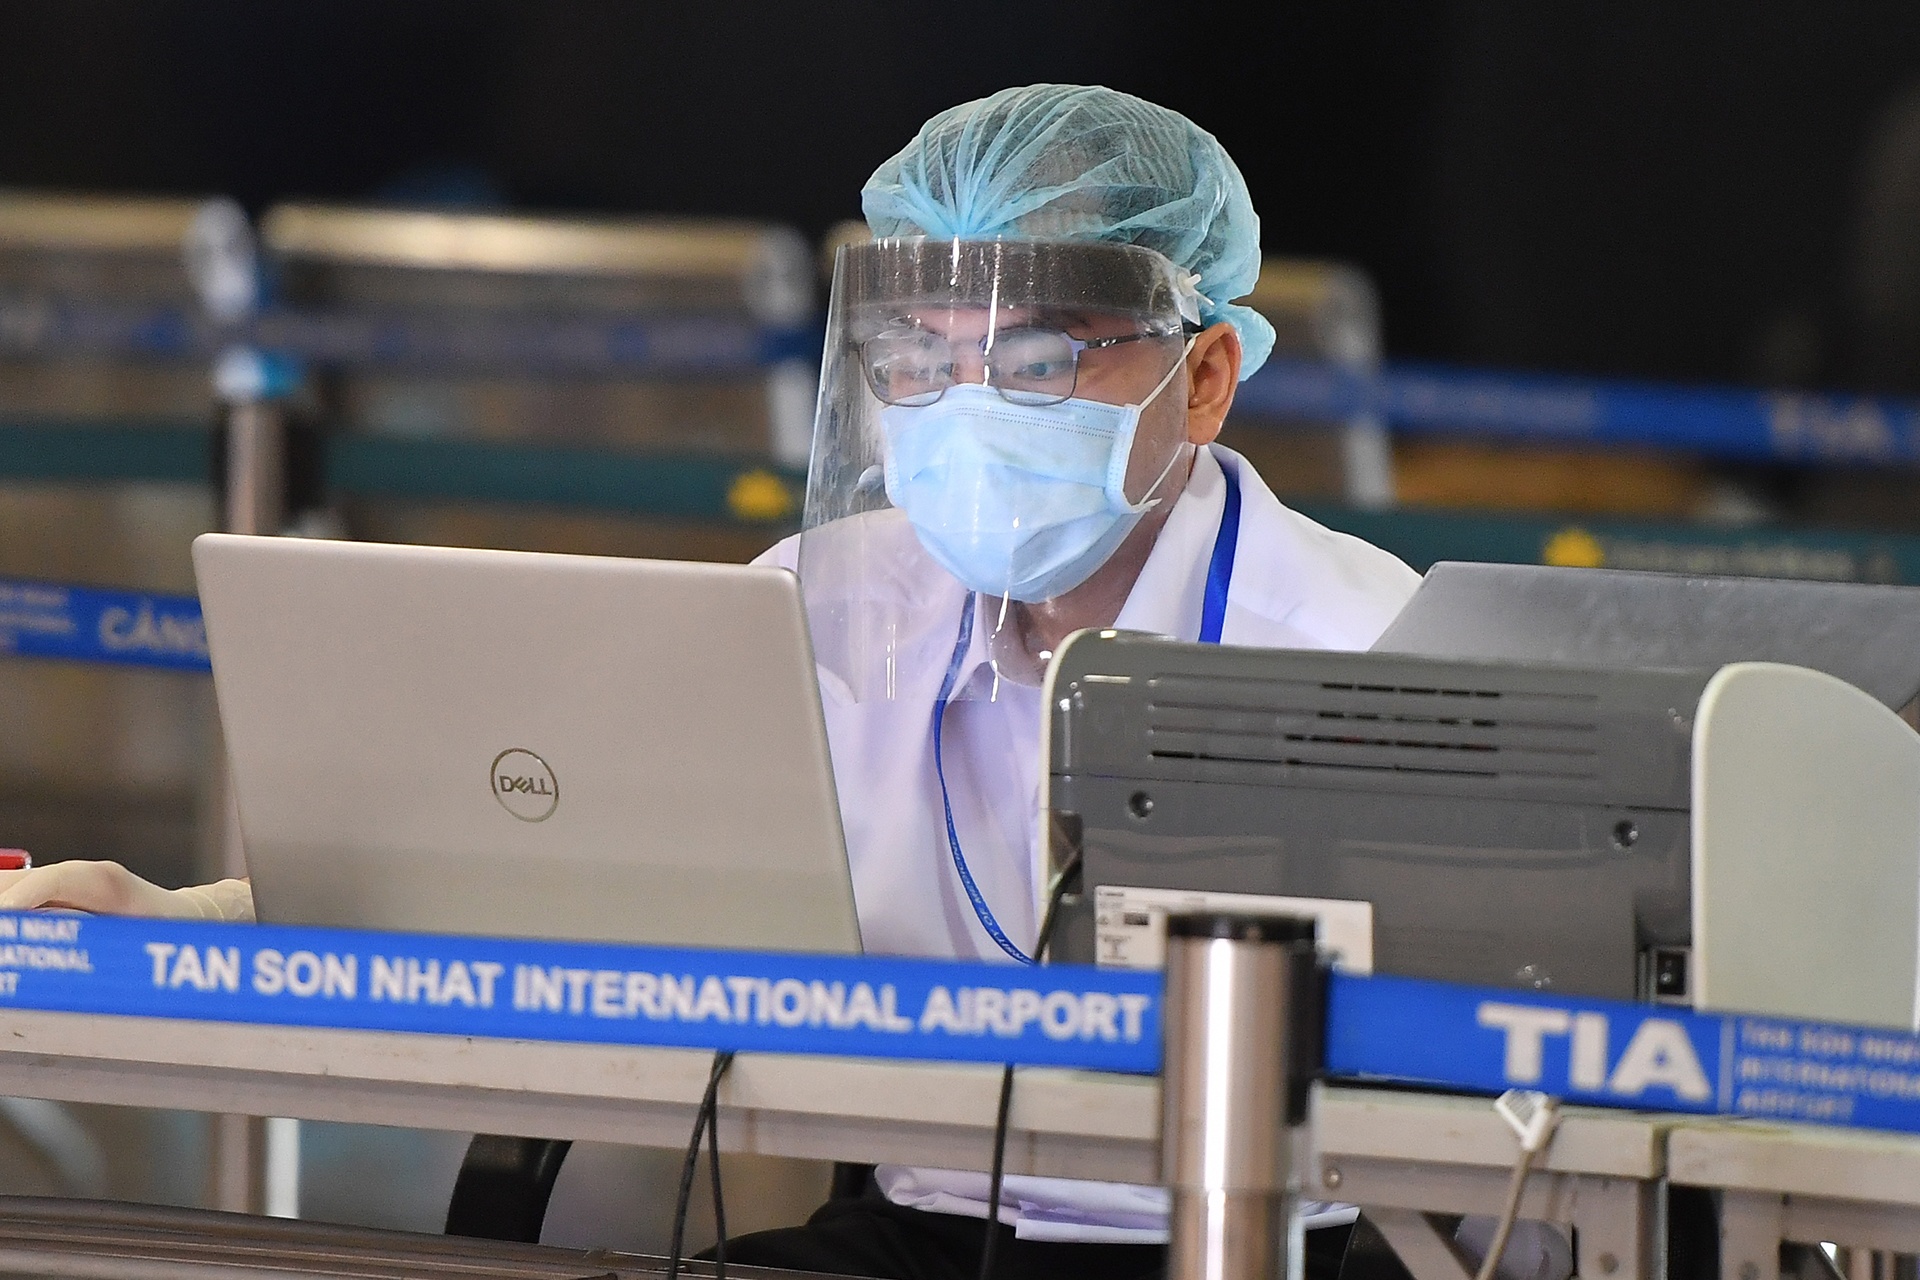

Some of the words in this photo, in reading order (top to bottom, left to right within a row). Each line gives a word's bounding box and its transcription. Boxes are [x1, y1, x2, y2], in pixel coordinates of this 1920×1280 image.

[499, 775, 552, 795] DELL
[0, 944, 95, 972] ATIONAL
[144, 942, 239, 992] TAN
[253, 950, 358, 997] SON
[370, 957, 503, 1008] NHAT
[513, 963, 912, 1031] INTERNATIONAL
[919, 986, 1148, 1042] AIRPORT
[1476, 1001, 1712, 1103] TIA
